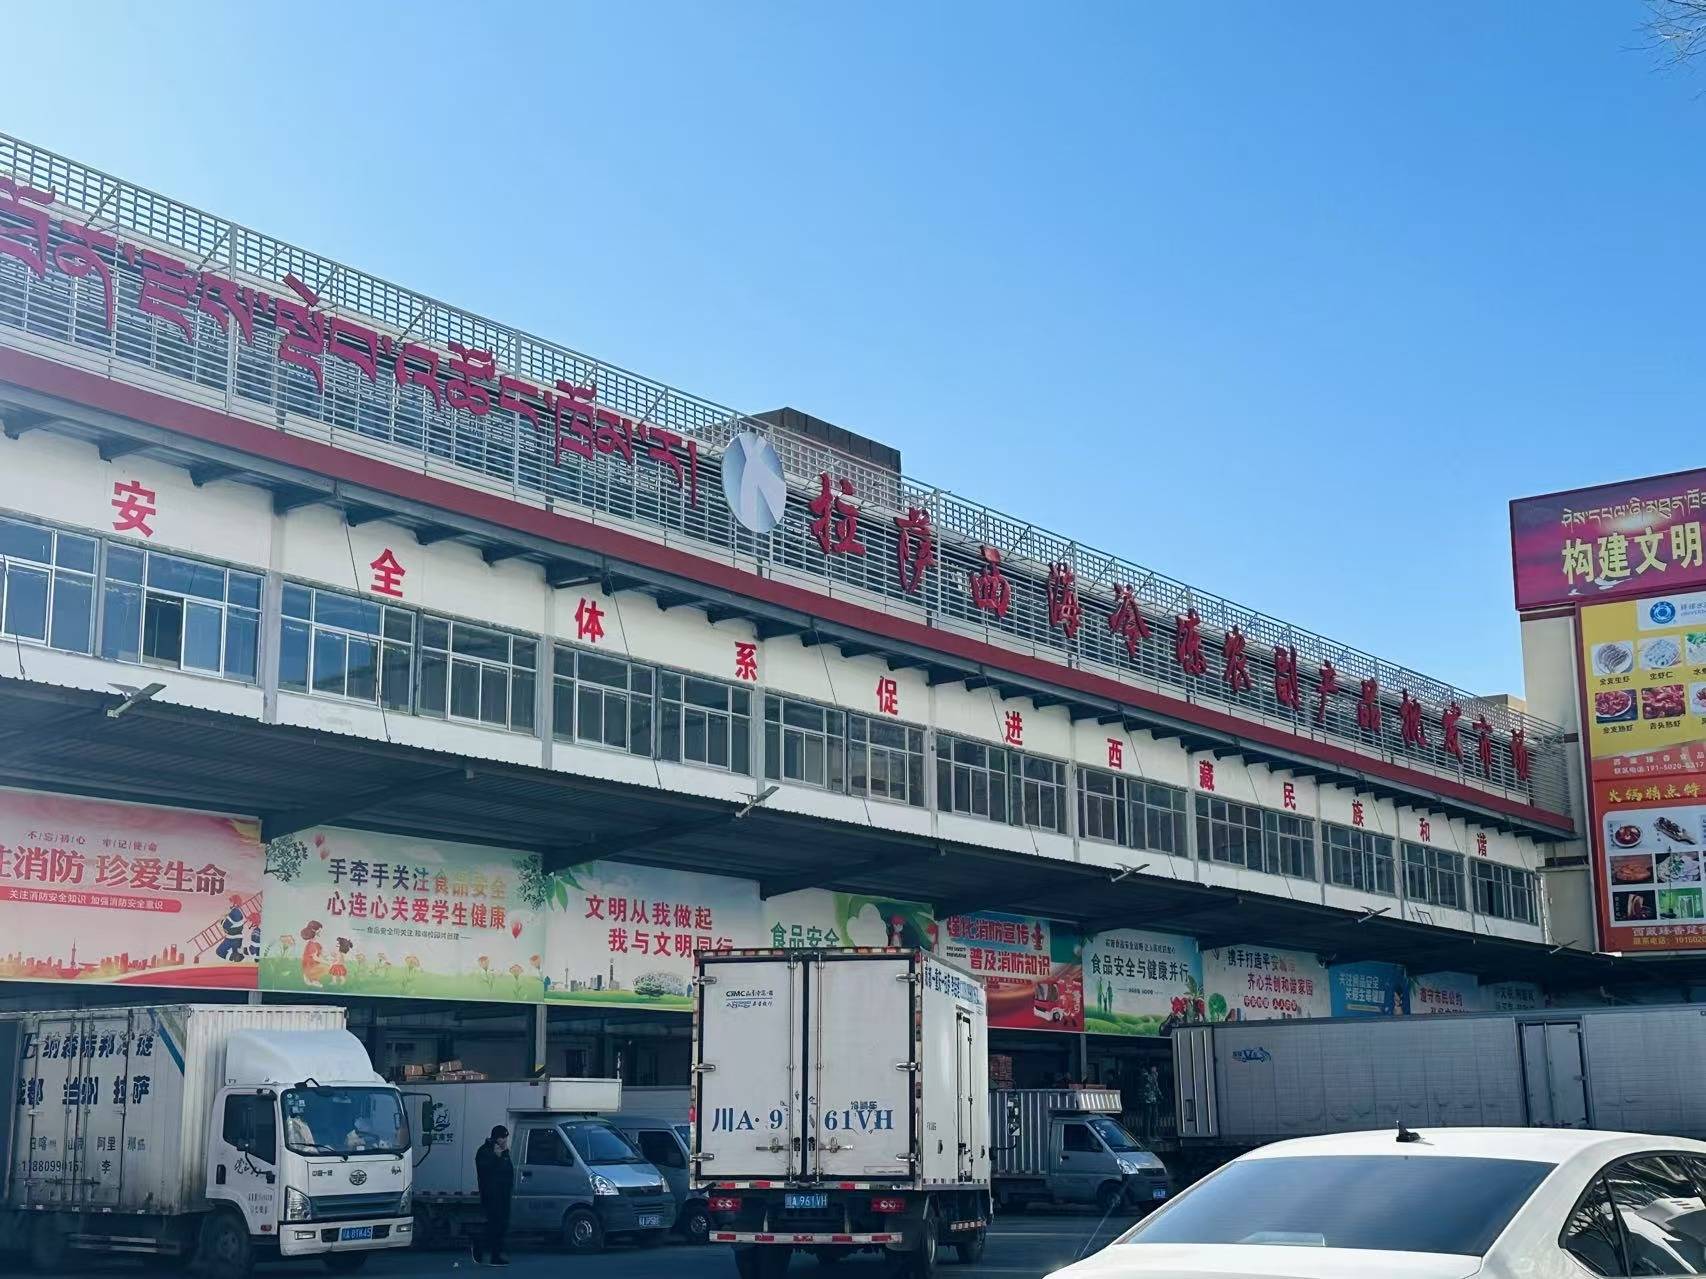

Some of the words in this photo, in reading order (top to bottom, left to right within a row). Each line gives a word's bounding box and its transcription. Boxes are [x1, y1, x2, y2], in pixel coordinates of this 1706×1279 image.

[1562, 522, 1703, 585] 构建文明
[96, 853, 227, 897] 珍爱生命
[328, 858, 507, 899] 手牵手关注食品安全
[9, 889, 86, 904] 关注消防安全知识
[91, 898, 164, 911] 加强消防安全意识
[327, 891, 506, 930] 心连心关爱学生健康
[584, 894, 713, 930] 文明从我做起
[608, 927, 734, 958] 我与文明同行
[770, 921, 840, 948] 食品安全
[969, 947, 1051, 976] 普及消防知识
[1091, 953, 1189, 982] 食品安全与健康并行
[62, 1076, 98, 1105] 兰州
[113, 1075, 151, 1104] 拉萨
[824, 1109, 894, 1131] 61VH
[97, 1136, 116, 1151] 阿里
[101, 1160, 112, 1174] 李
